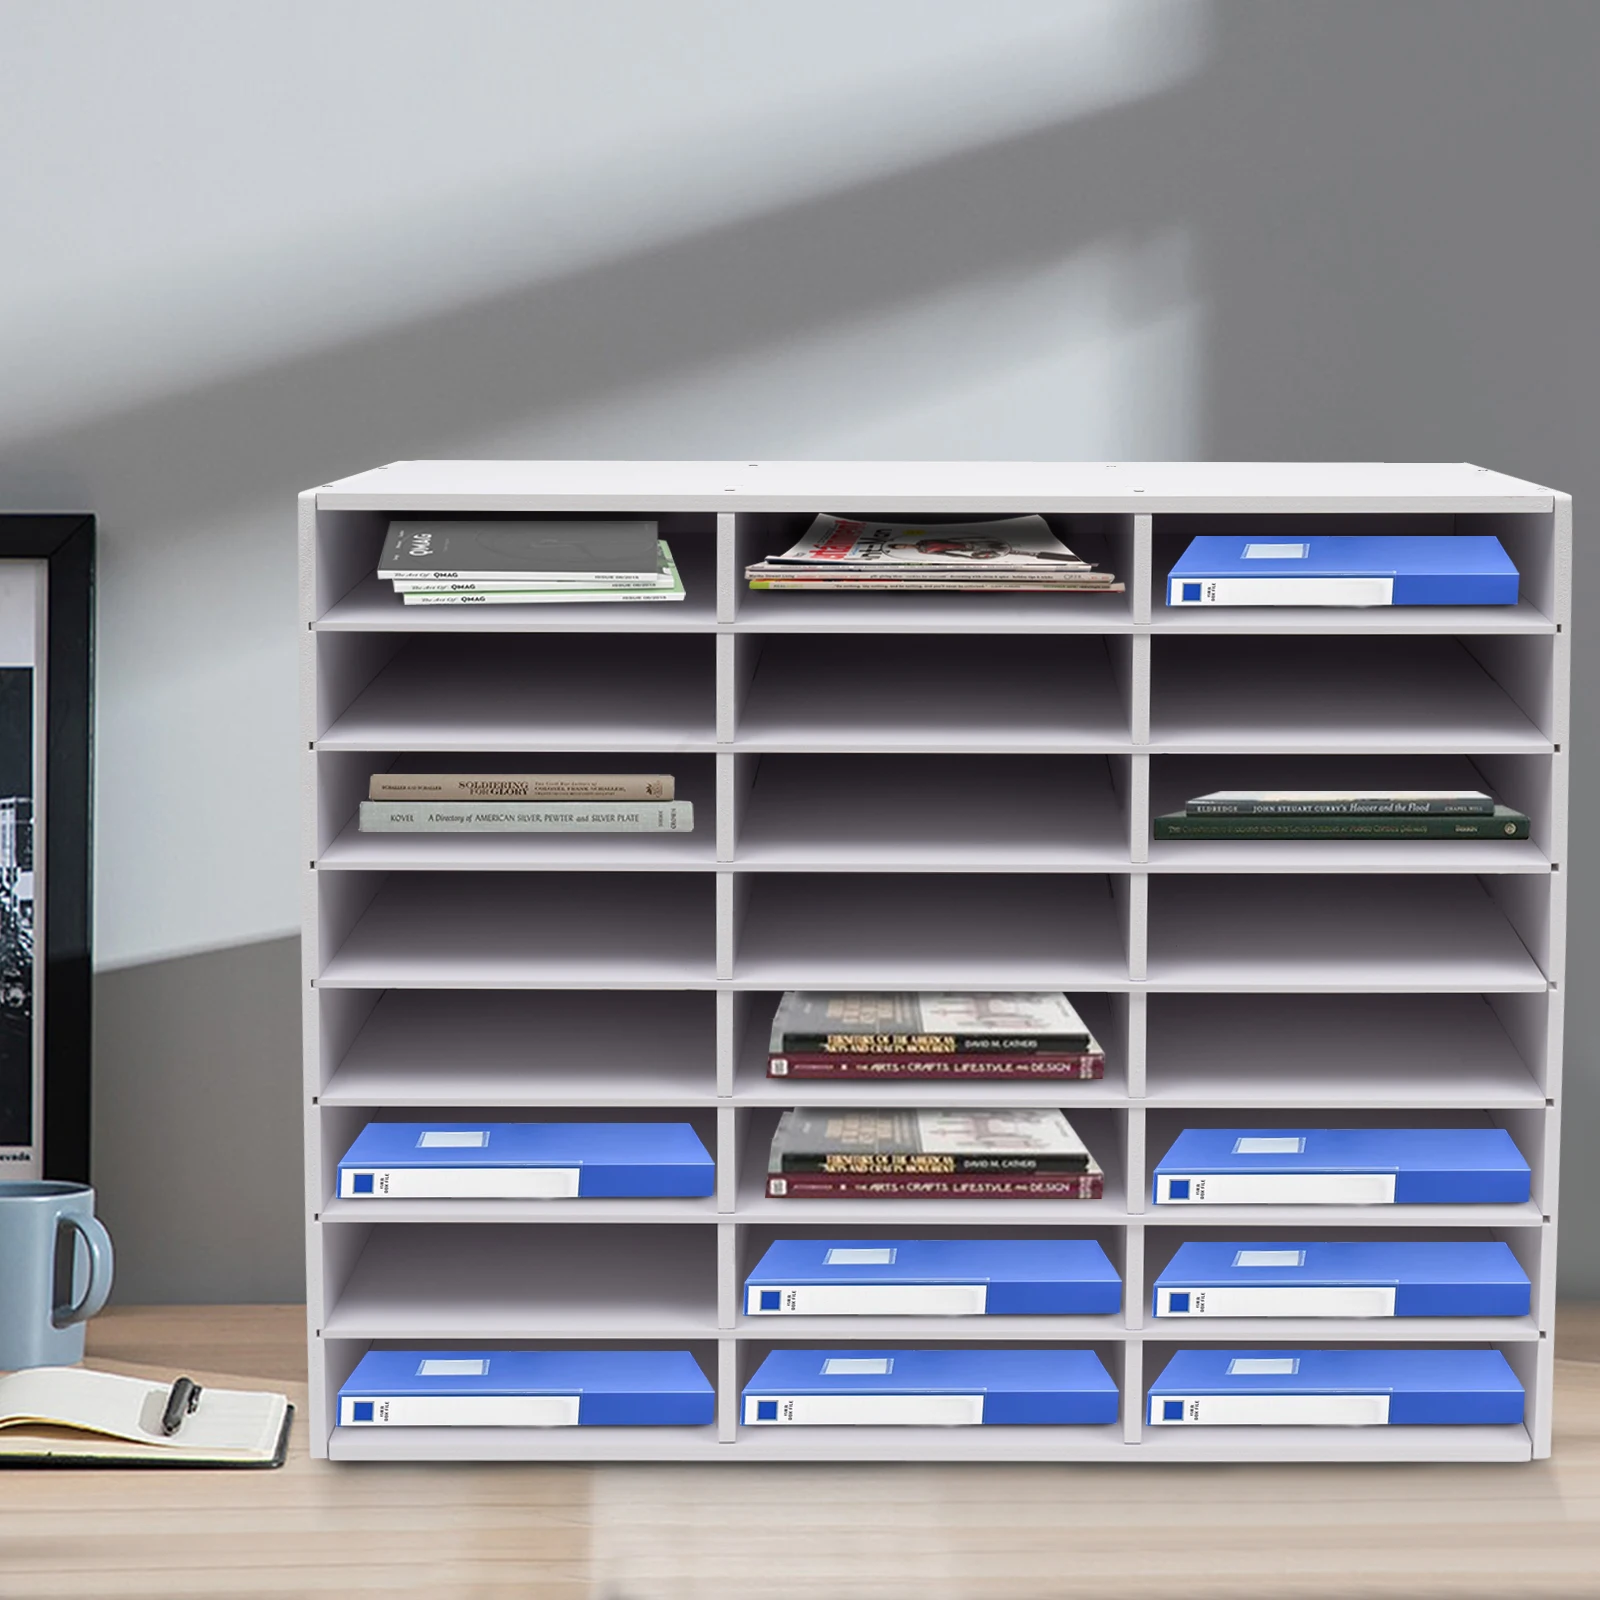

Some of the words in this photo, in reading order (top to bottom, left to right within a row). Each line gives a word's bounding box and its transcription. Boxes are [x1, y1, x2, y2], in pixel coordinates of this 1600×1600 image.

[458, 781, 528, 789] SOLDIERING
[1379, 804, 1391, 812] and
[1393, 804, 1406, 812] the
[1408, 803, 1430, 812] Flood
[390, 814, 414, 822] KOVEL
[436, 814, 464, 824] Directory
[465, 814, 473, 822] of
[475, 814, 515, 822] AMERICAN
[517, 814, 542, 823] SILVER,
[544, 814, 573, 822] PEWTER
[964, 1040, 989, 1048] DAVID
[1003, 1040, 1037, 1048] CATHERS
[869, 1063, 899, 1072] ARTS
[907, 1063, 949, 1072] CRAFTS
[954, 1063, 1013, 1072] LIFESTYLE
[1031, 1063, 1071, 1072] DESIGN
[964, 1160, 988, 1168] DAVID
[1002, 1160, 1036, 1168] CATHERS
[868, 1183, 898, 1192] ARTS
[906, 1183, 948, 1192] CRAFTS
[953, 1183, 1012, 1192] LIFESTYLE
[1030, 1183, 1070, 1192] DESIGN
